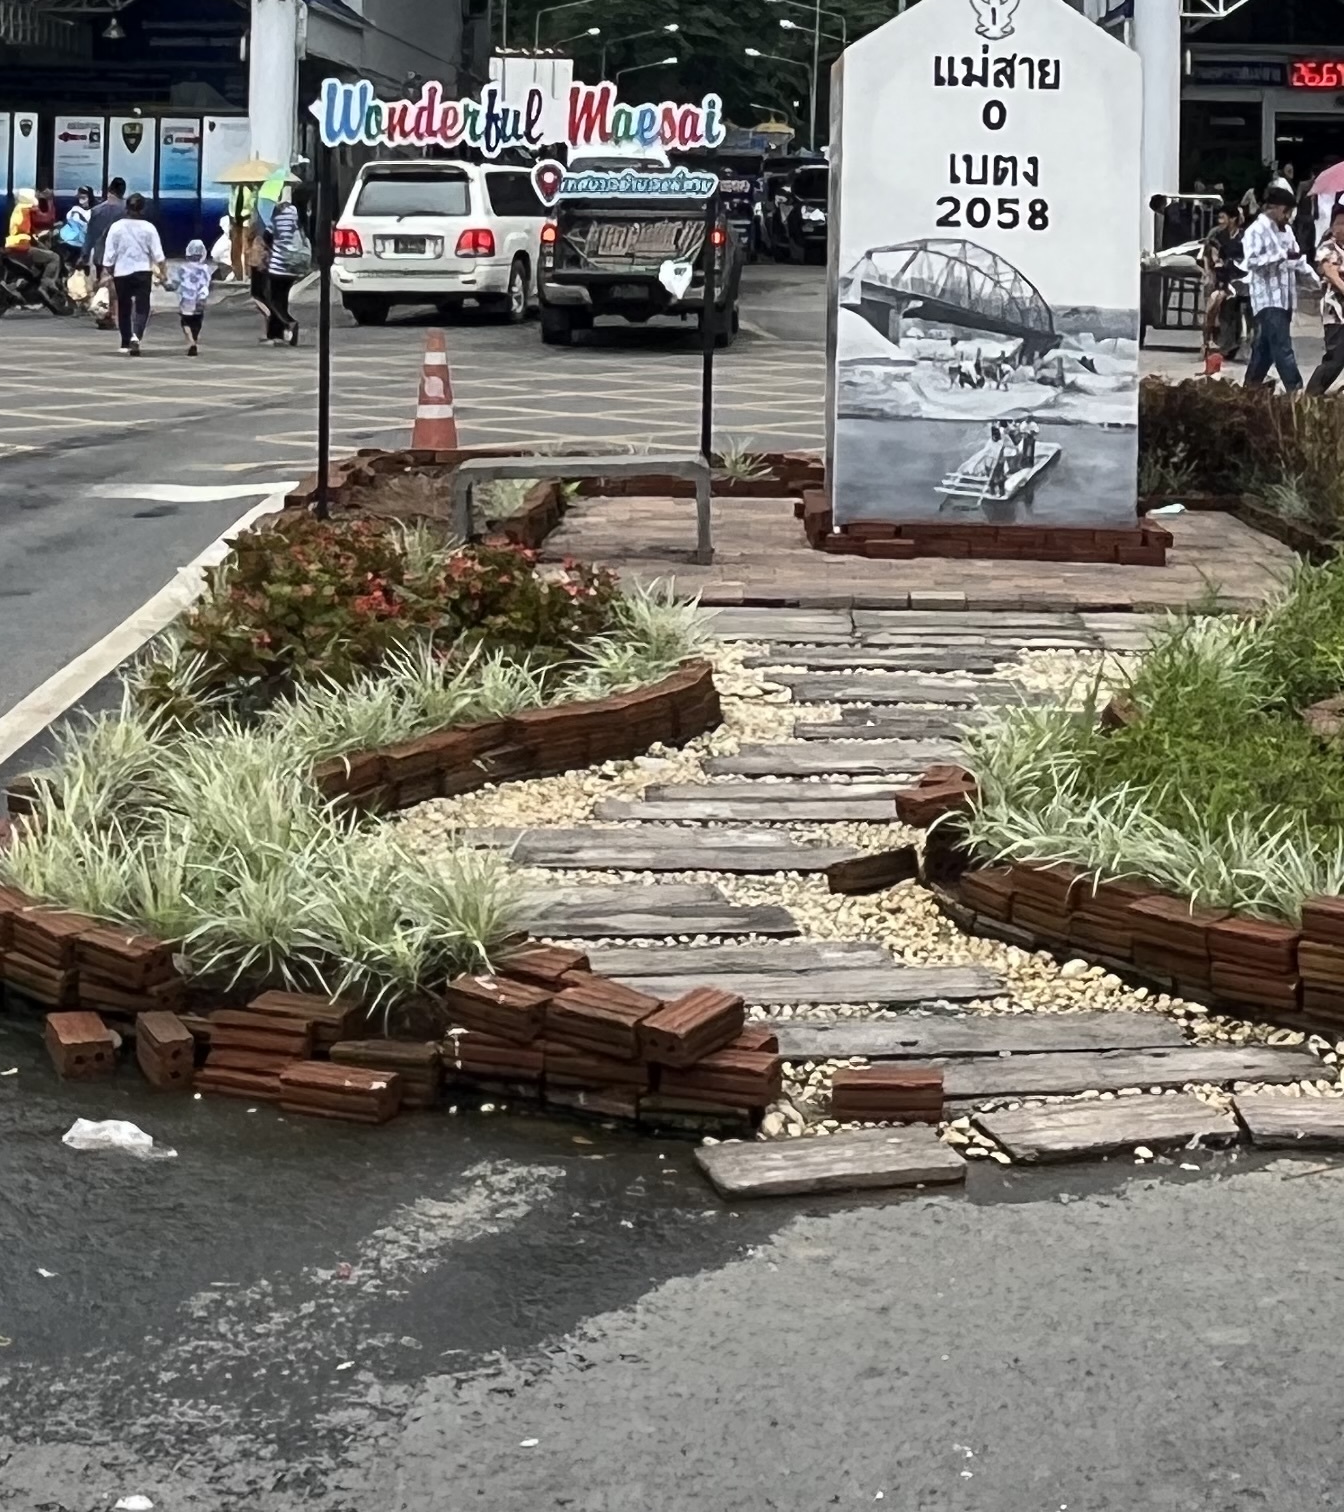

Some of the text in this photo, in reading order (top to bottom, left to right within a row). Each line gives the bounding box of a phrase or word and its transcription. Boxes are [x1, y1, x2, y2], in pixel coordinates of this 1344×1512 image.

[933, 44, 1061, 90] แม่สาย
[323, 82, 722, 153] Wonderful Maesai
[982, 99, 1007, 130] 0
[949, 153, 1039, 187] เบตง
[935, 196, 1049, 231] 2058
